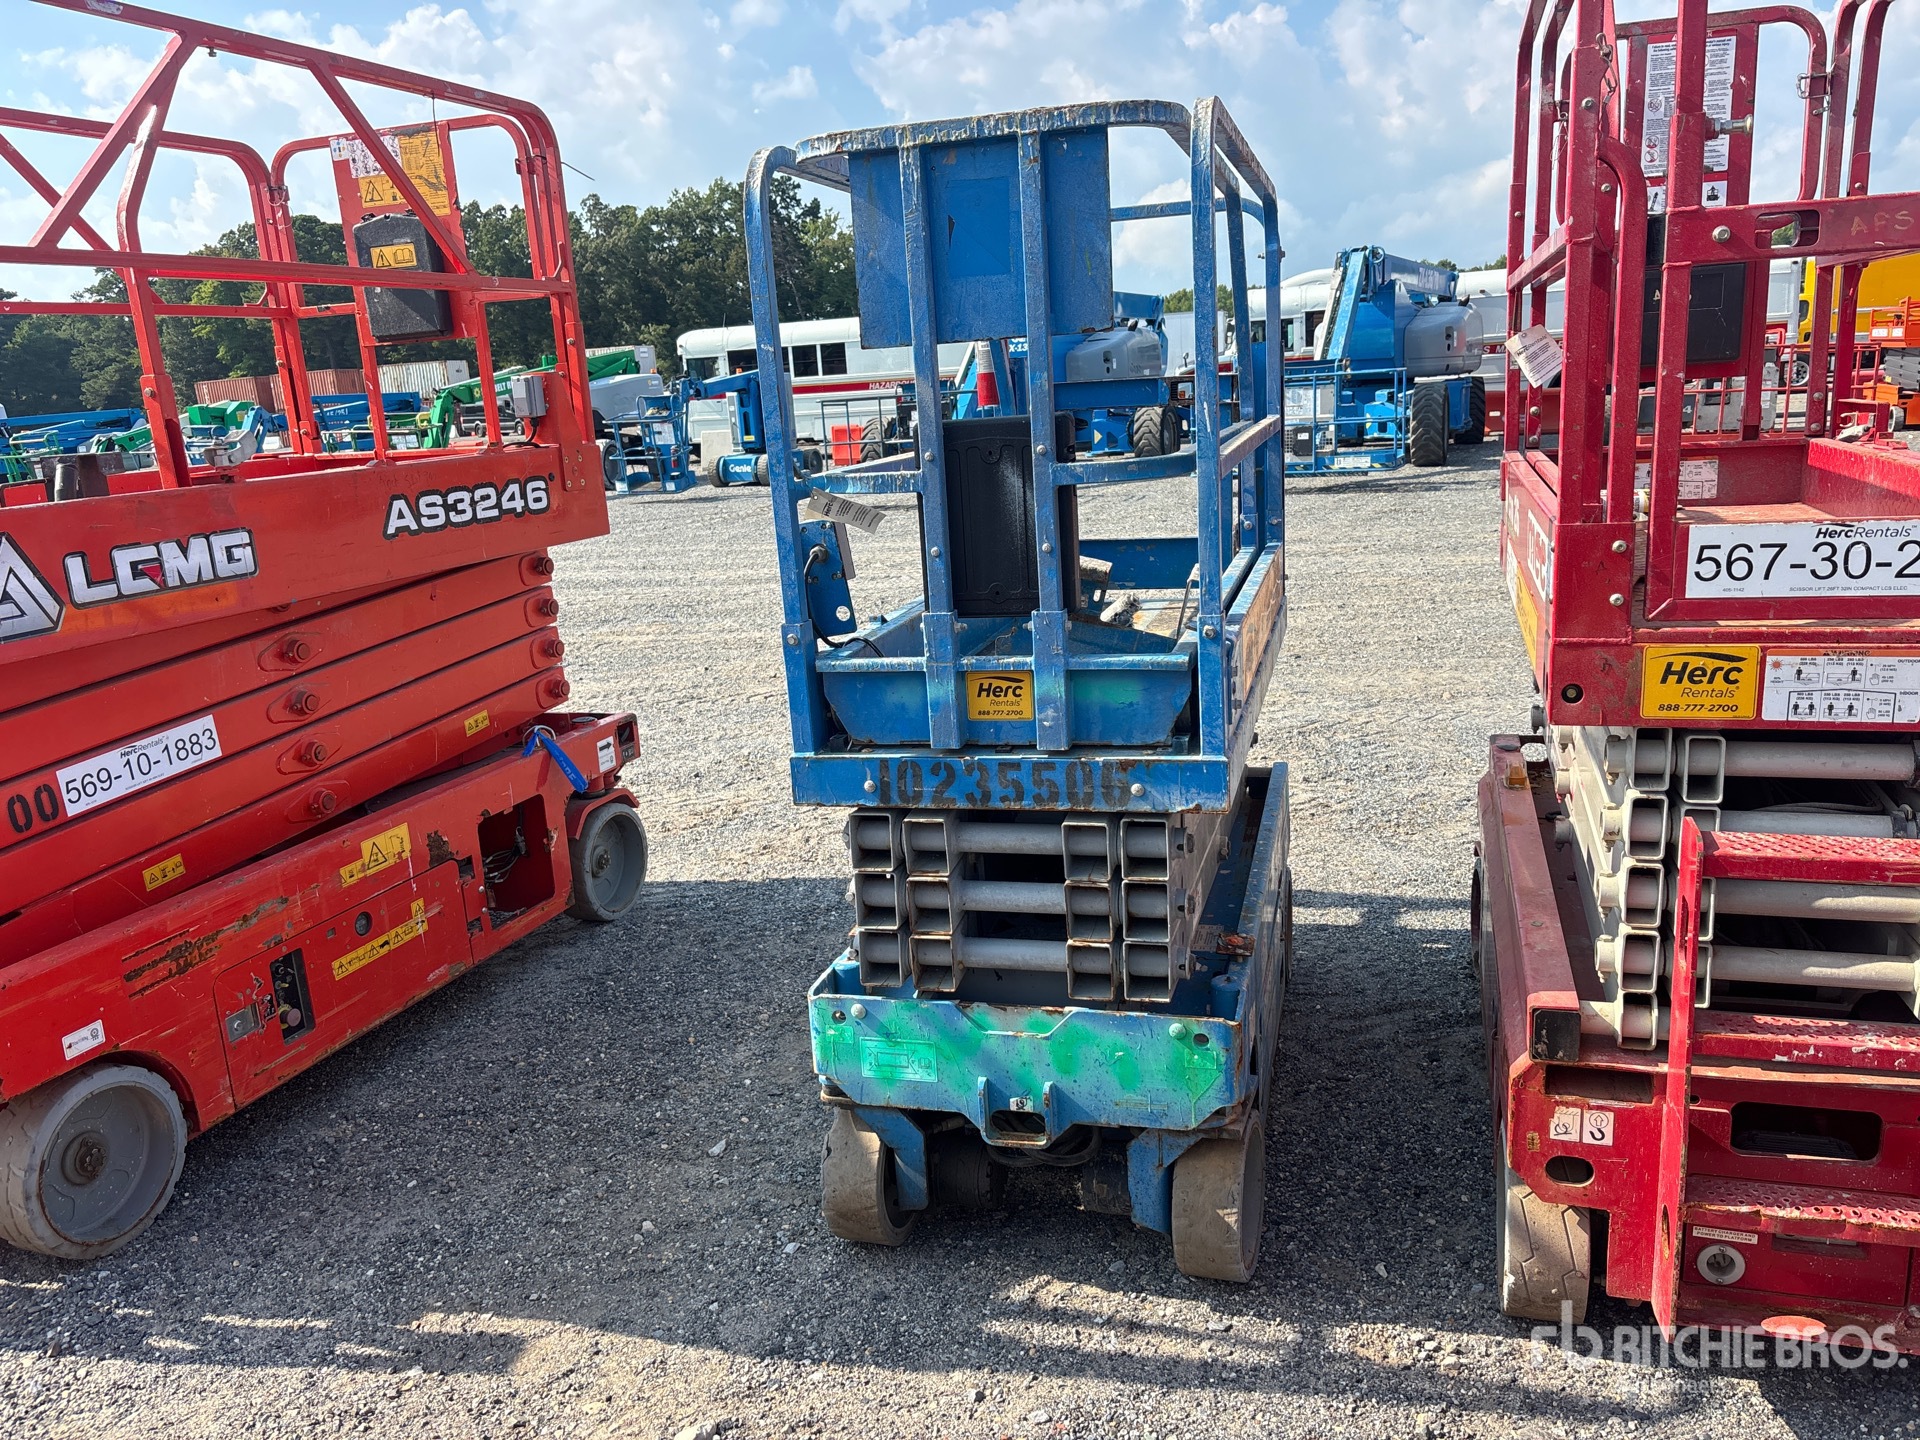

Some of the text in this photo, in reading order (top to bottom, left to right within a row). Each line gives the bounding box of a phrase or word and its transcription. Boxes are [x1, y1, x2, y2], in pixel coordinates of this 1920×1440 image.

[729, 463, 752, 473] Genie
[384, 478, 550, 536] AS3246
[1660, 661, 1744, 685] Herc
[976, 682, 1024, 698] Herc
[1658, 703, 1739, 713] 888-777-2700
[64, 727, 218, 805] 569-10-1883
[1694, 1226, 1718, 1234] BATTERY
[1717, 1229, 1744, 1237] CHARGER
[1724, 1234, 1753, 1242] PLATFORM
